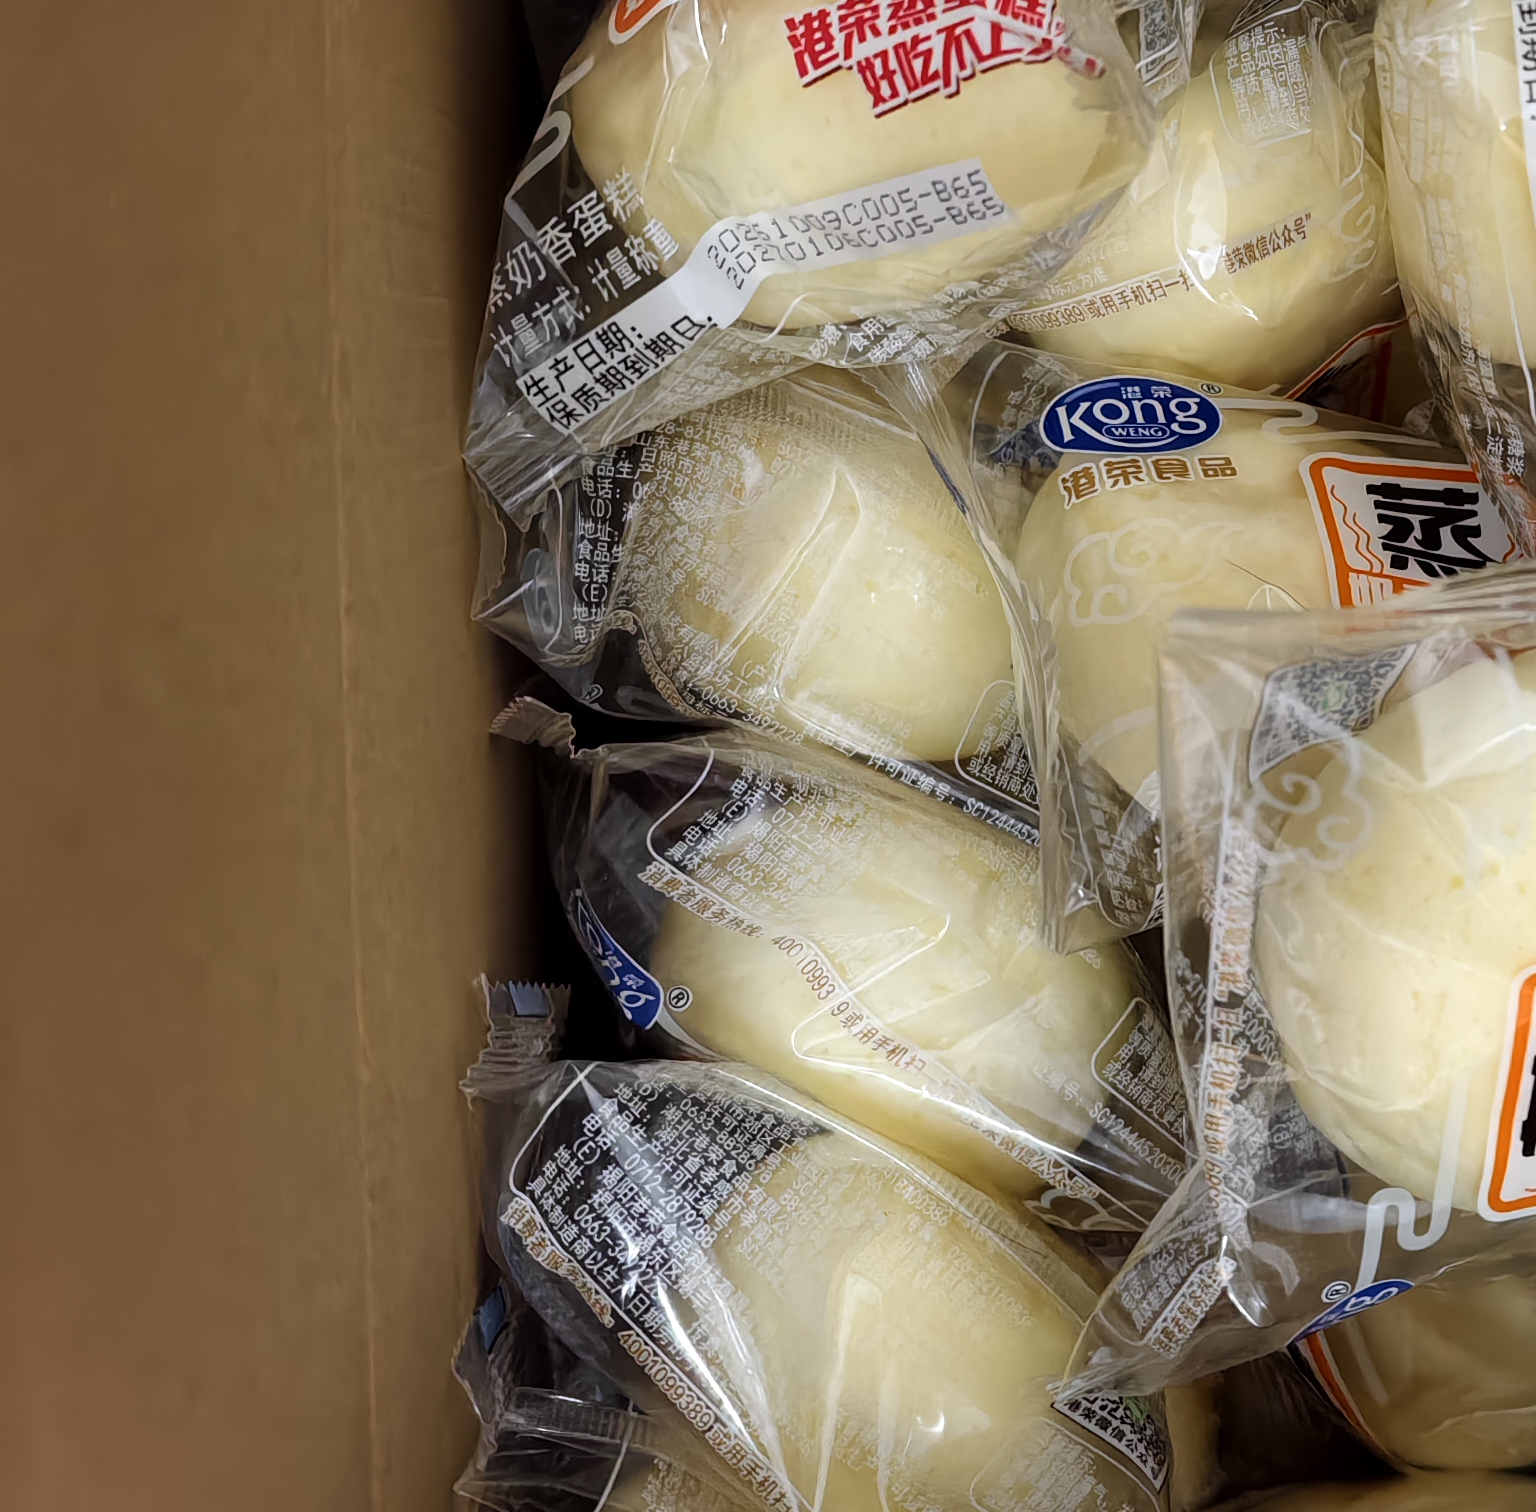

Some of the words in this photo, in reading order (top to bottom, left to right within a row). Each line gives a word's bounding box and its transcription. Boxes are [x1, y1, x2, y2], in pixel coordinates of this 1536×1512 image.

[523, 321, 644, 409] 生产日期：
[1055, 397, 1207, 448] Kong
[1110, 427, 1163, 438] WENG
[1060, 455, 1239, 509] 港荣食品
